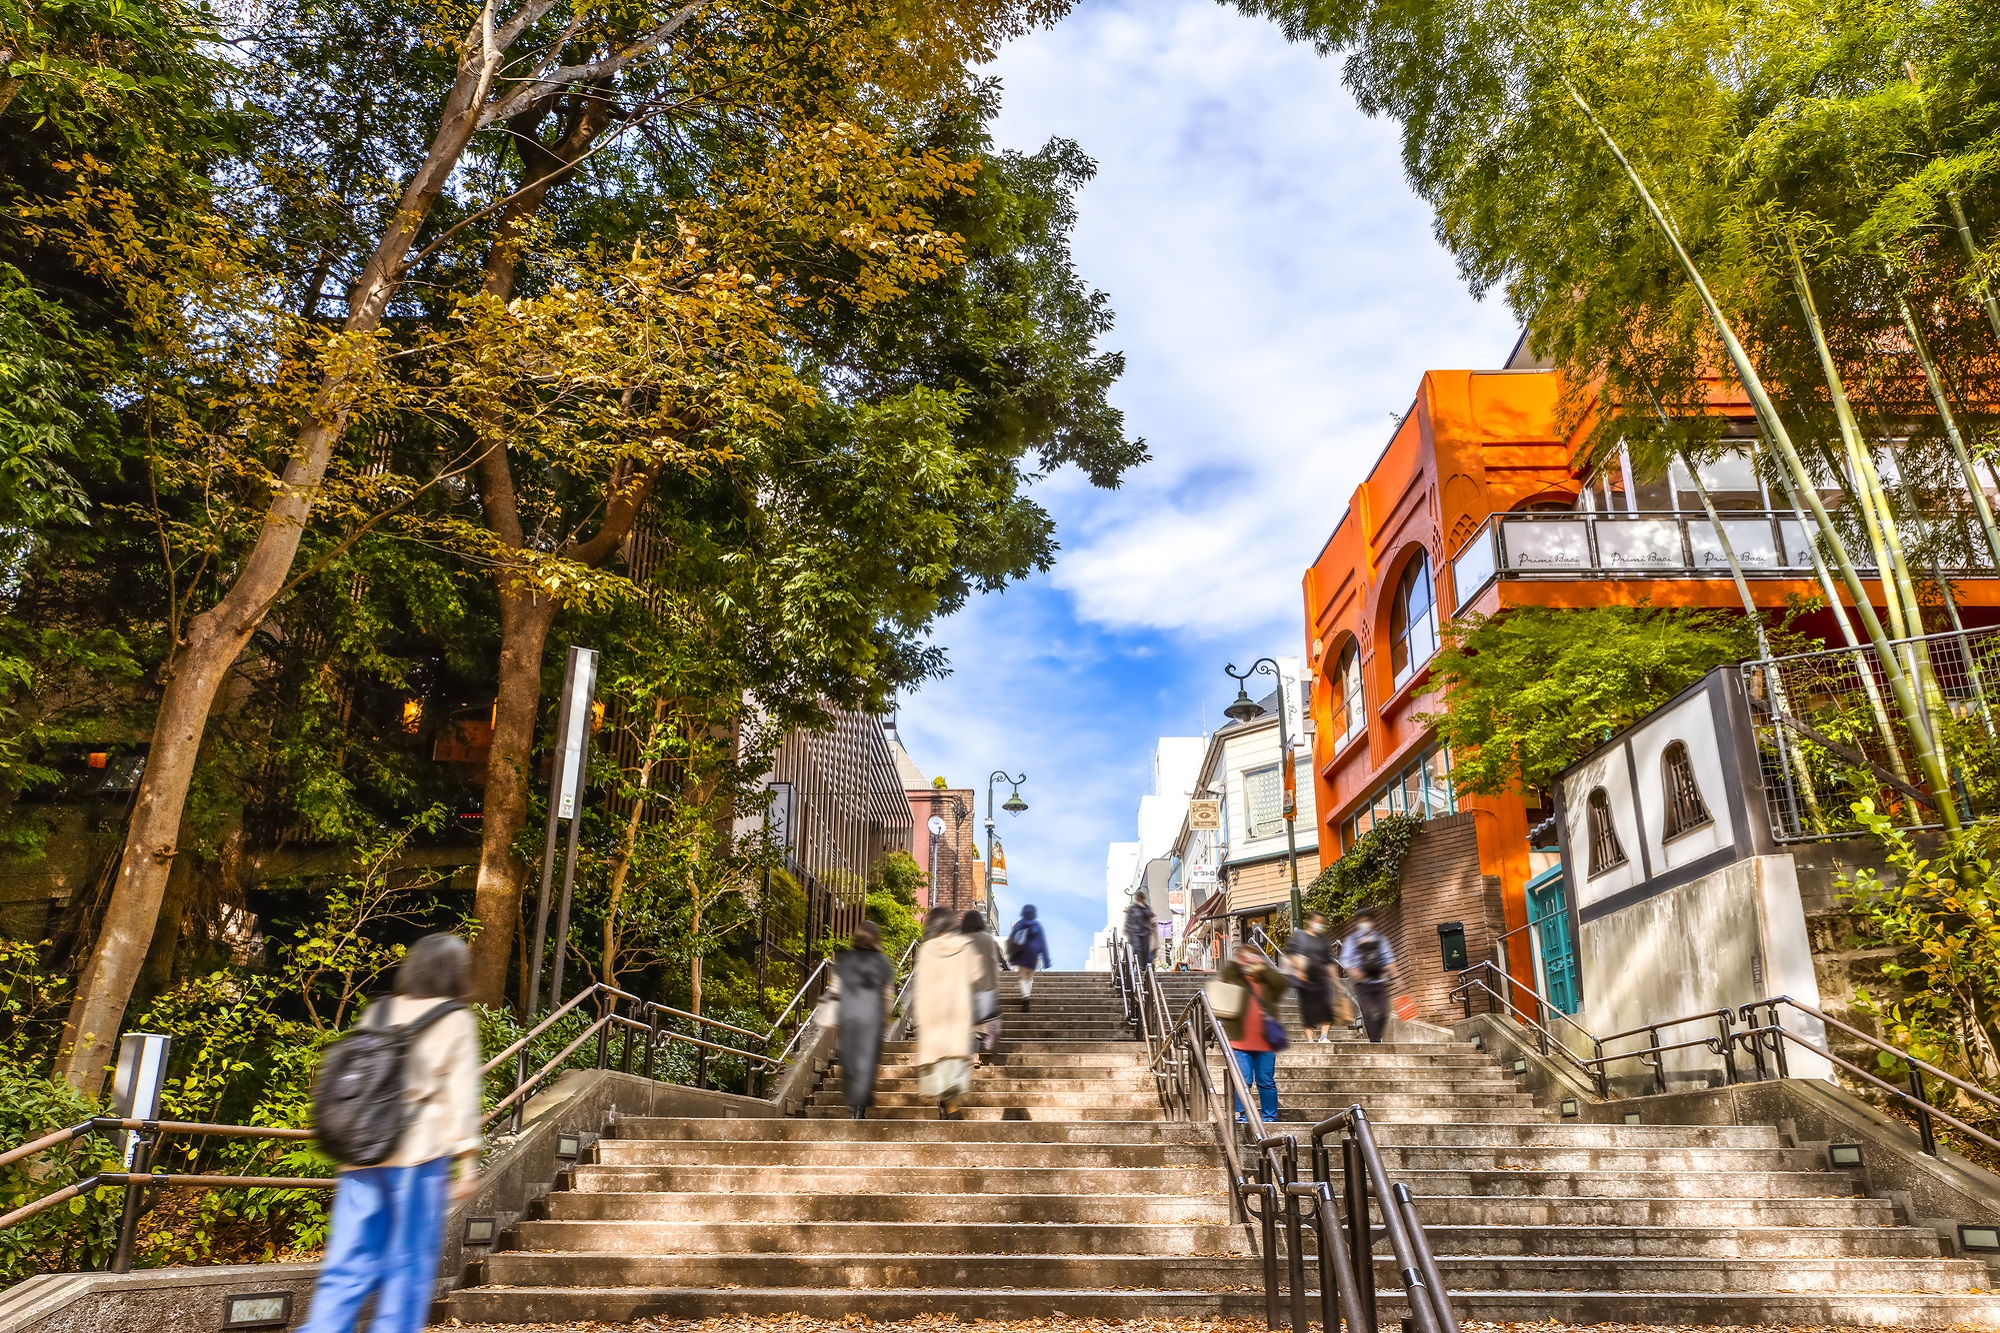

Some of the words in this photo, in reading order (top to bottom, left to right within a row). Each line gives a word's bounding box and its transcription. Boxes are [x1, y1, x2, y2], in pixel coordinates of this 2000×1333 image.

[1519, 552, 1553, 567] Primi
[1554, 552, 1580, 563] Baci
[1611, 551, 1645, 566] Primi
[1647, 551, 1673, 562] Baci
[1704, 551, 1739, 565] Prii
[1740, 551, 1767, 562] Baci
